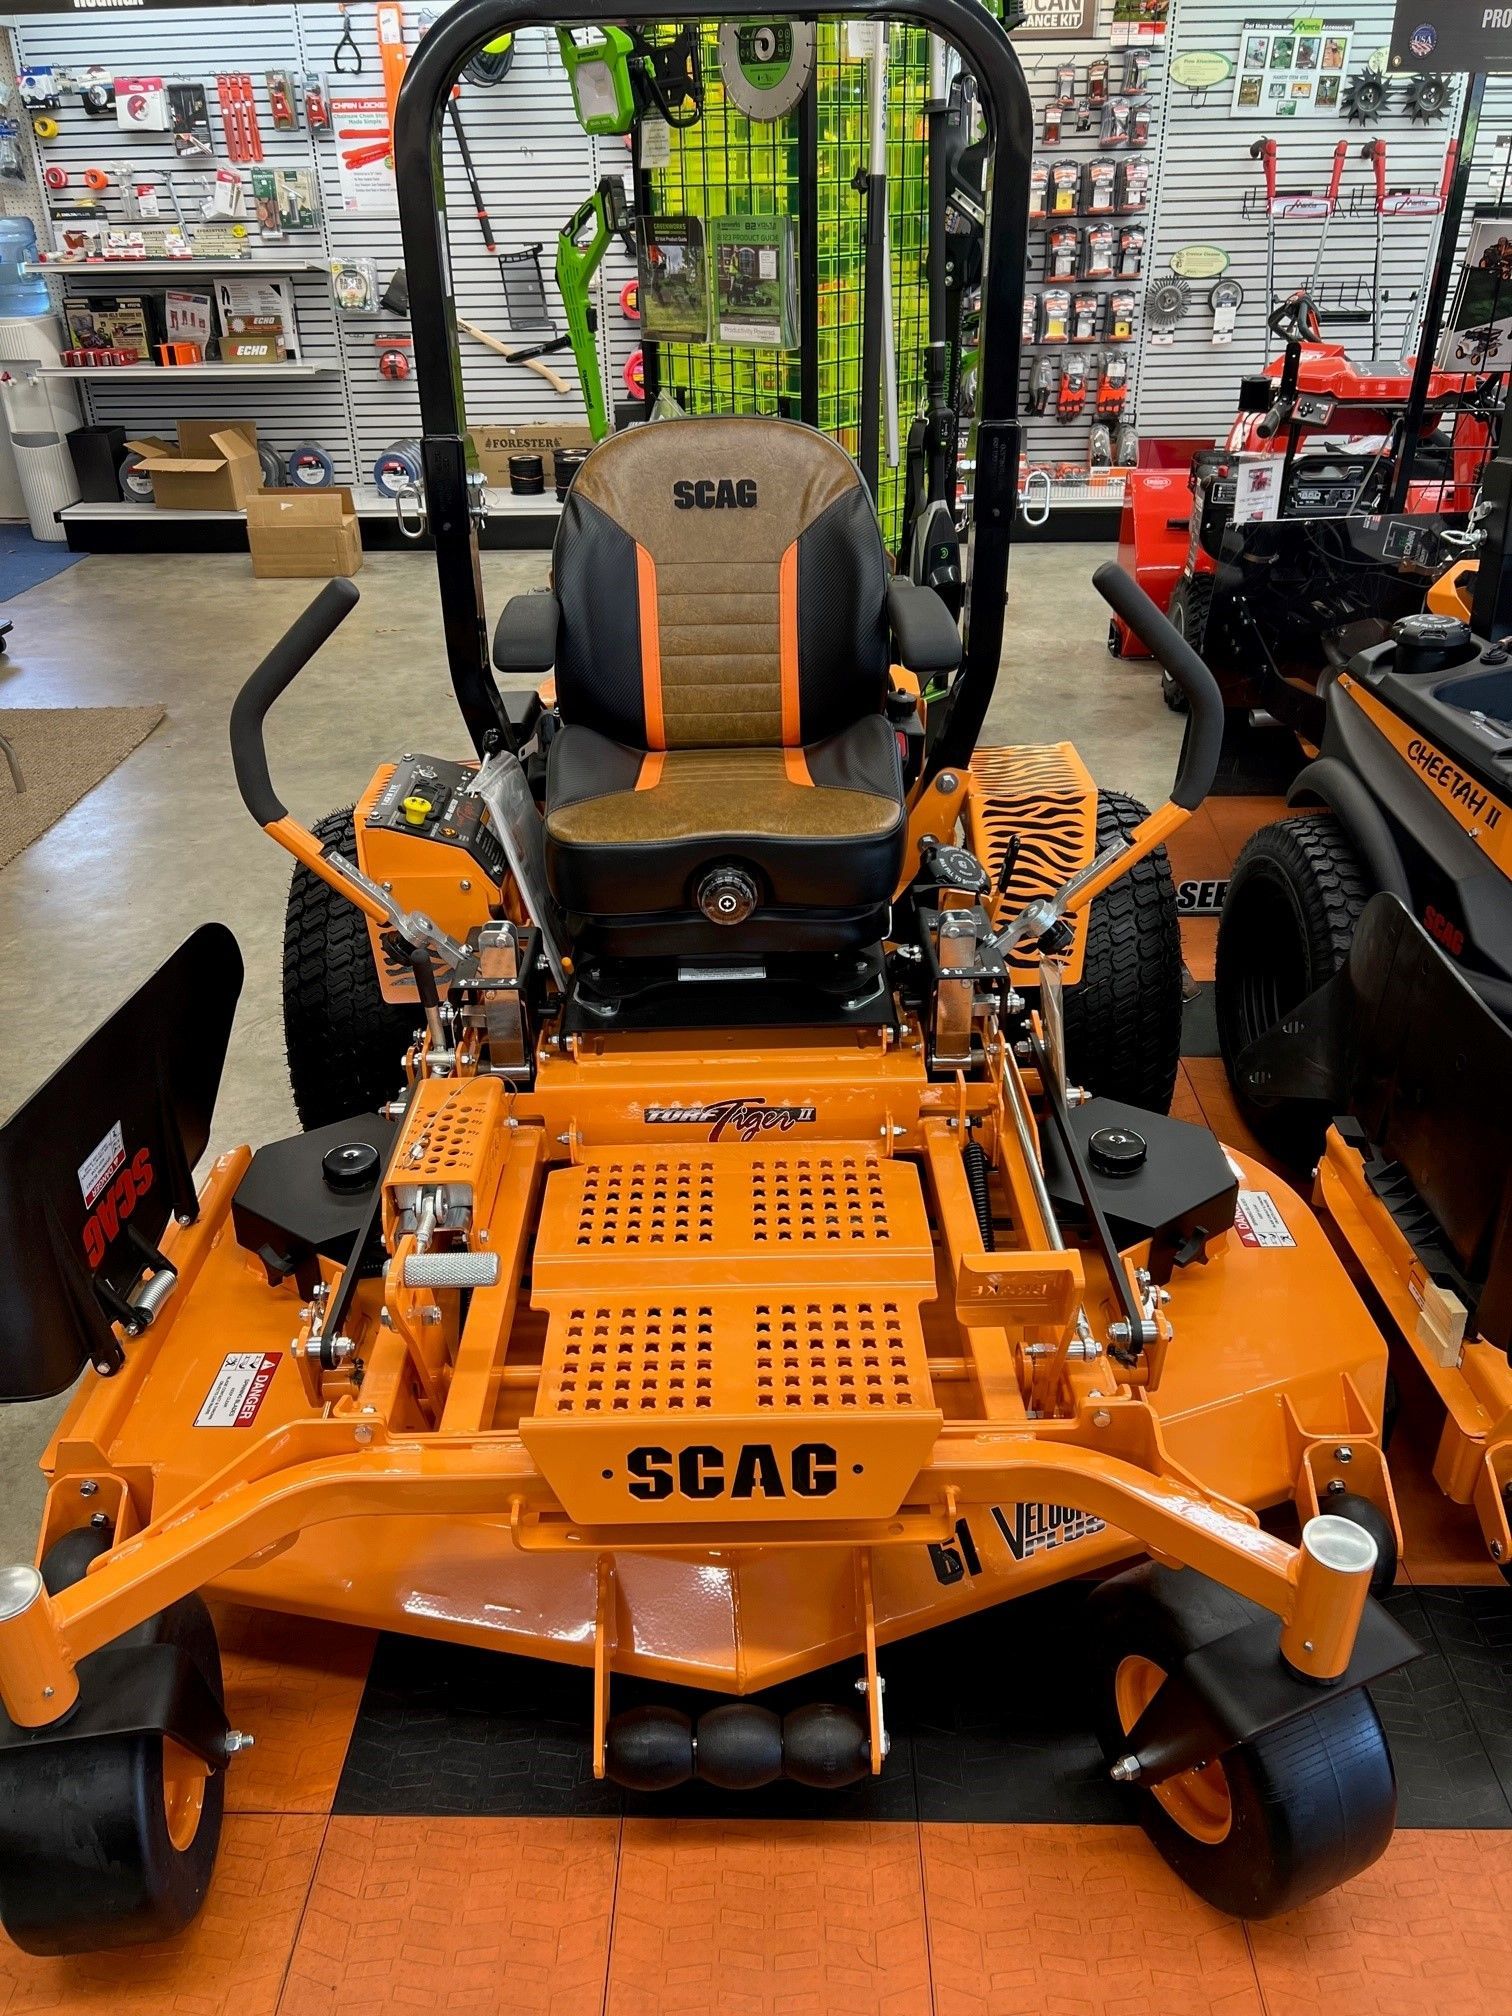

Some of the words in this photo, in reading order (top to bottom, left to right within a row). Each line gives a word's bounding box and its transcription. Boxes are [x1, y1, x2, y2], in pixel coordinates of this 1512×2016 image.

[1060, 14, 1081, 27] KIT
[1414, 35, 1432, 44] USA
[331, 101, 358, 110] CHAIN
[358, 101, 388, 110] LOCKE
[253, 317, 275, 325] ECHO
[236, 345, 268, 356] ECHO
[492, 438, 554, 449] FORESTER
[673, 479, 758, 510] SCAG
[1407, 740, 1488, 818] CHEETAH
[1484, 805, 1502, 830] II
[1424, 905, 1464, 956] SCAG
[646, 1108, 721, 1122] TURF
[703, 1097, 796, 1142] Tiger
[797, 1108, 815, 1121] II
[91, 1166, 115, 1198] DANGER
[83, 1147, 154, 1268] SCAG
[238, 1374, 269, 1419] DANGER
[627, 1442, 838, 1502] SCAG
[926, 1517, 983, 1586] 61
[1024, 1516, 1107, 1558] PLUS
